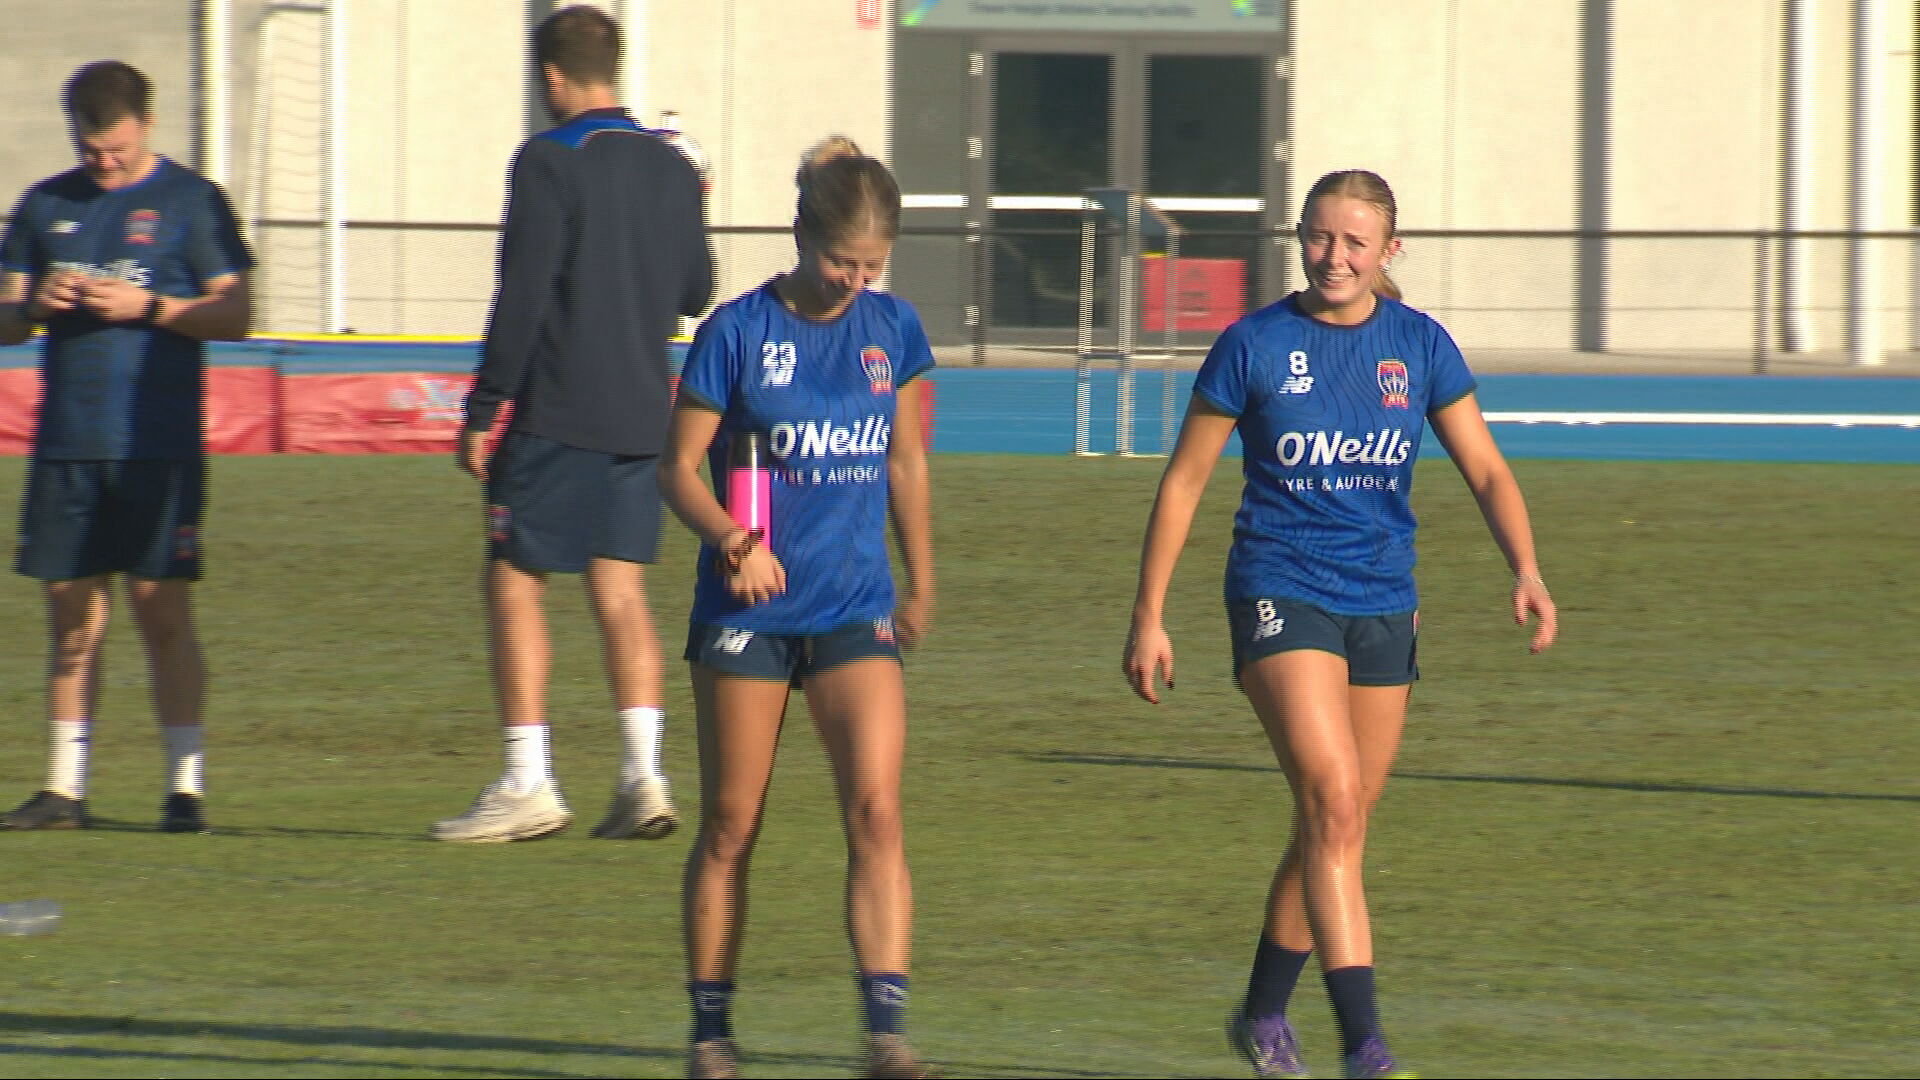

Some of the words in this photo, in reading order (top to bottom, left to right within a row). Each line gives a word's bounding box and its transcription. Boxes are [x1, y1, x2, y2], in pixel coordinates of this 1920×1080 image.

[762, 340, 797, 368] 23
[1288, 350, 1309, 376] 8
[770, 415, 889, 458] O'Neills
[1276, 429, 1410, 466] O'Neills
[1322, 477, 1332, 492] &
[1256, 599, 1277, 622] 8
